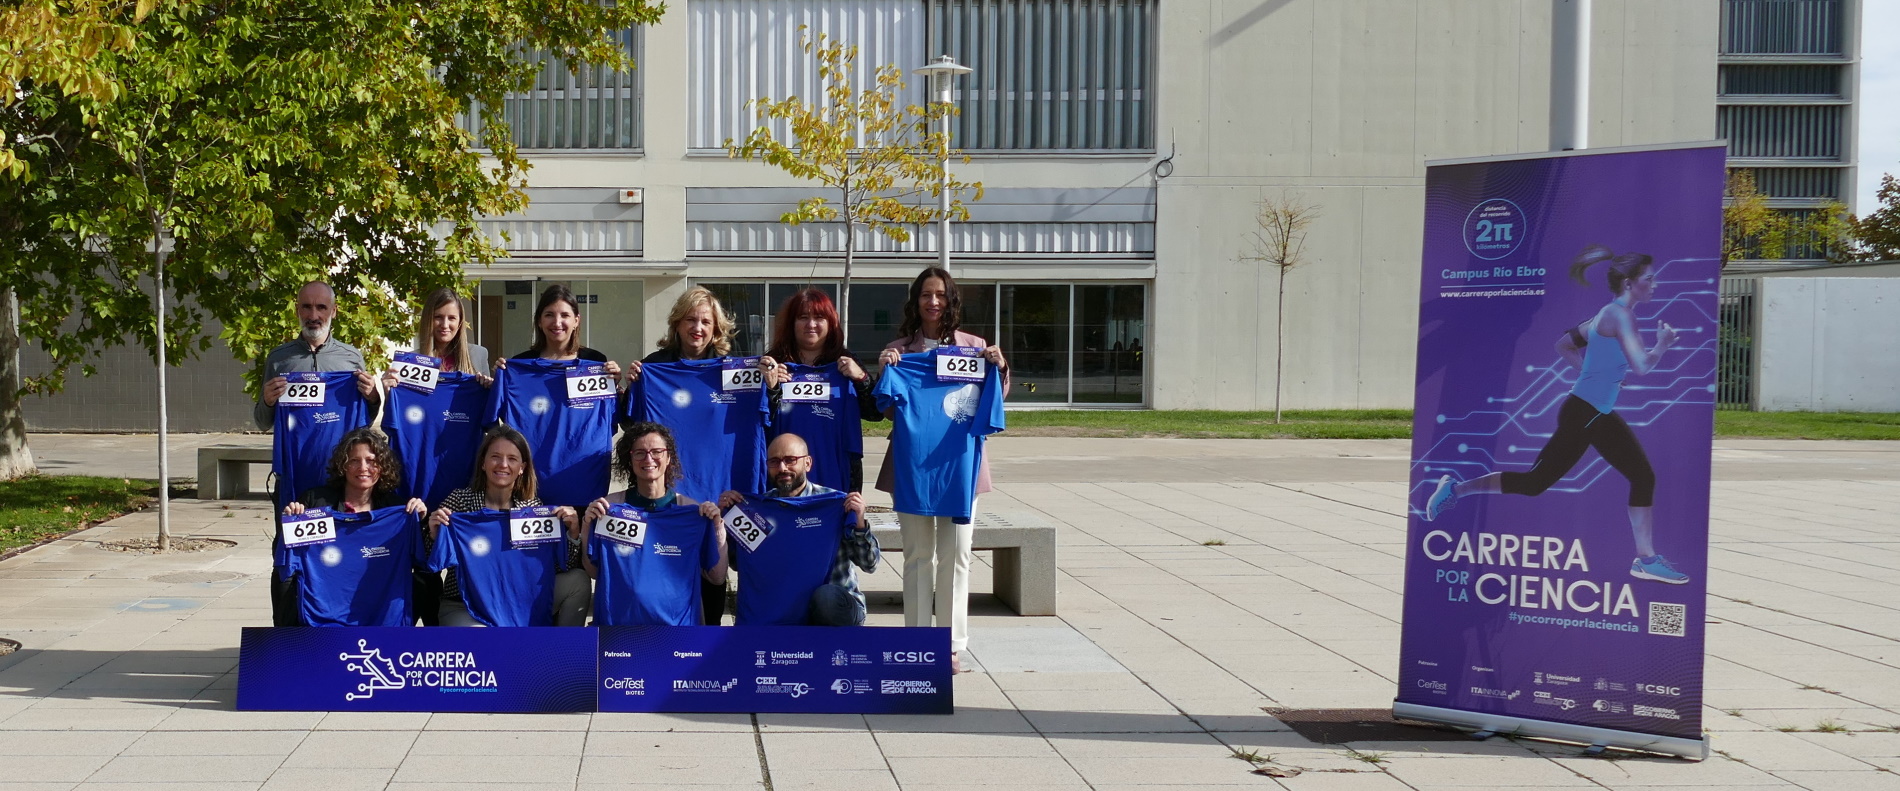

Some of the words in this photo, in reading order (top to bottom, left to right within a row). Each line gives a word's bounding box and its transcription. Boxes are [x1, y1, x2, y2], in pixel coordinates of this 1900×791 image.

[1476, 220, 1513, 242] 2π
[1441, 269, 1490, 281] Campus
[1493, 266, 1512, 278] Río
[1516, 266, 1546, 277] Ebro
[1440, 288, 1545, 299] www.carreraporlaciencia.es
[947, 358, 978, 372] 628
[400, 365, 431, 382] 628
[732, 370, 761, 385] 628
[287, 384, 319, 398] 628
[577, 377, 608, 392] 628
[792, 383, 823, 396] 628
[294, 521, 327, 538] 628
[521, 519, 554, 535] 628
[605, 519, 639, 538] 628
[732, 515, 760, 542] 628
[1422, 530, 1589, 572] CARRERA
[1436, 569, 1469, 585] POR
[1448, 587, 1468, 602] LA
[1475, 573, 1640, 617] CIENCIA
[1508, 611, 1639, 633] #yocorroporlaciencia
[399, 652, 476, 668] CARRERA
[771, 651, 814, 659] Universidad
[894, 651, 936, 663] CSIC
[406, 671, 423, 679] POR
[412, 679, 422, 687] LA
[424, 670, 498, 687] CIENCIA
[755, 676, 777, 685] CEEI
[1546, 673, 1580, 683] Universidad
[604, 677, 645, 689] CerTest
[673, 680, 721, 689] ITAINNOVA
[1417, 679, 1447, 691] CerTest
[1645, 684, 1680, 696] CSIC
